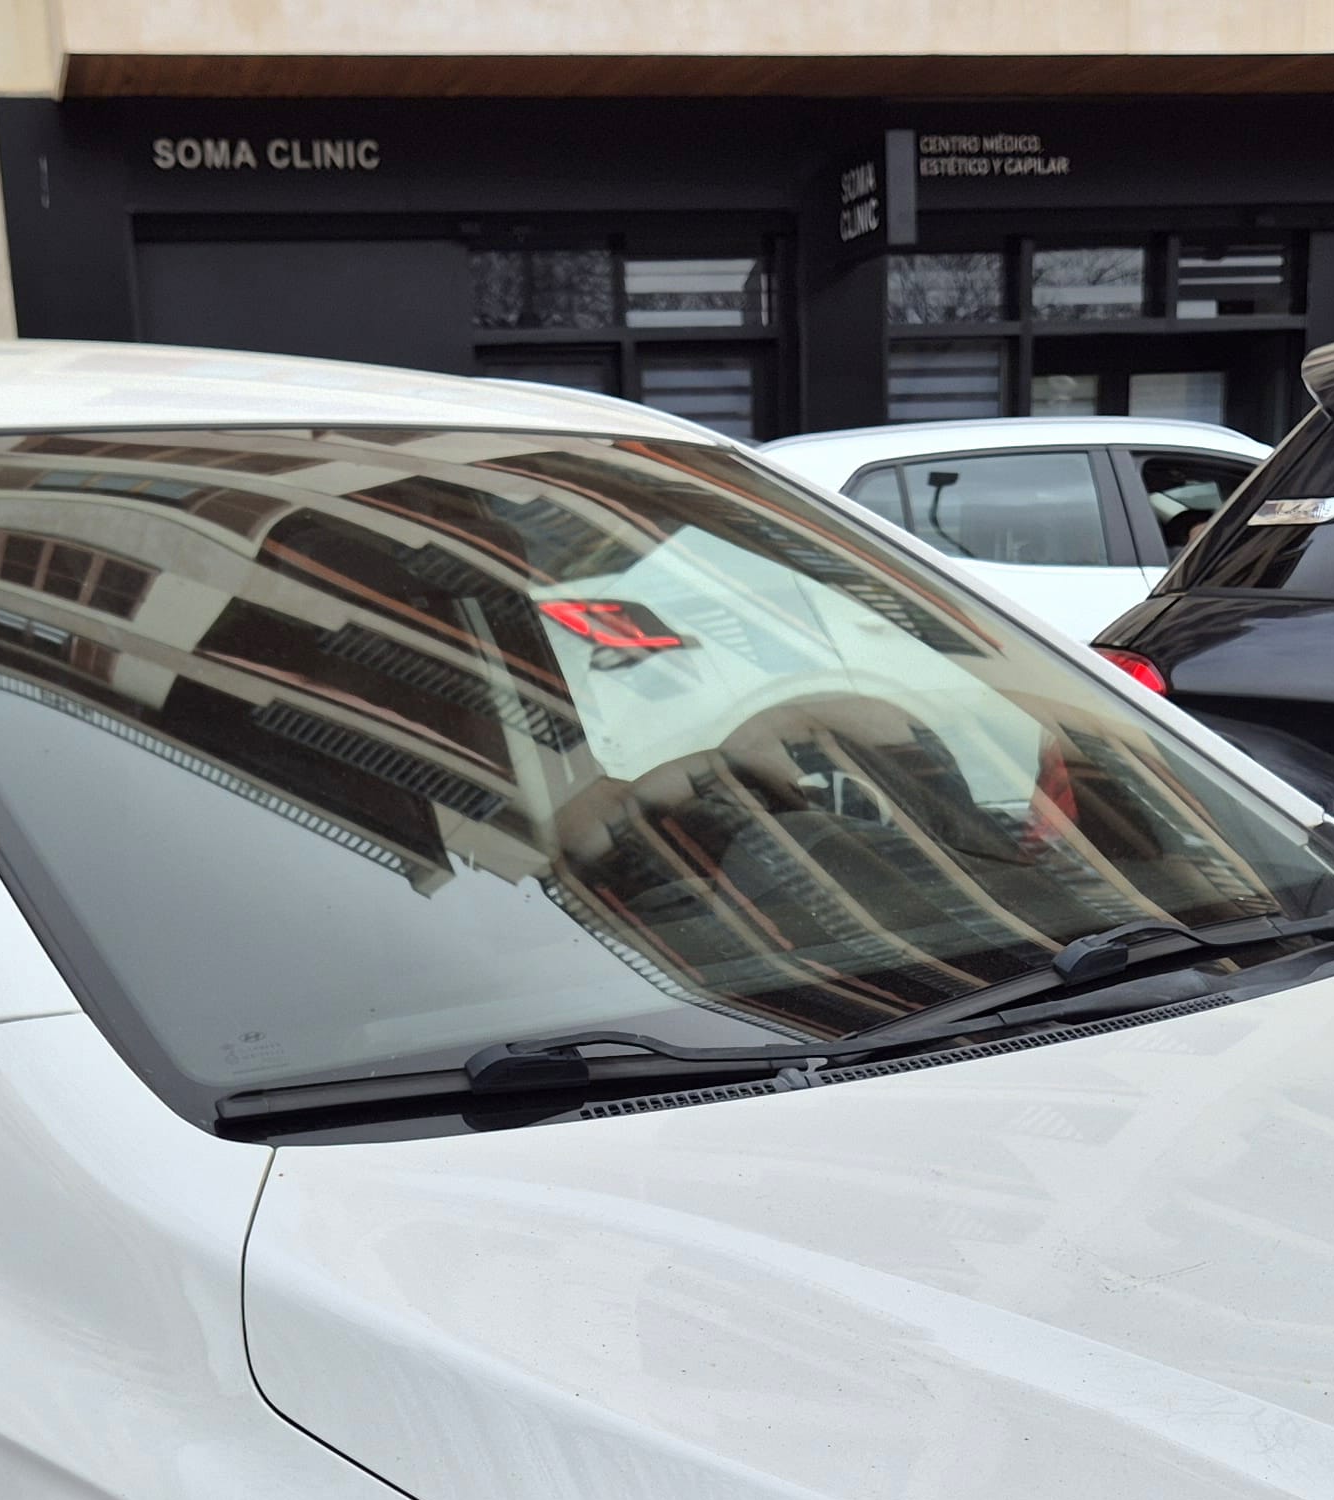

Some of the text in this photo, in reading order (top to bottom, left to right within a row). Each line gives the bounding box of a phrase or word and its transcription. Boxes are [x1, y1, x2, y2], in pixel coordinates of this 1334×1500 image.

[153, 137, 381, 170] SOMA CLINIC
[919, 135, 980, 154] CENTRO
[919, 154, 1070, 176] ESTÉTICO Y CAPILAR
[840, 198, 880, 242] CLINIC
